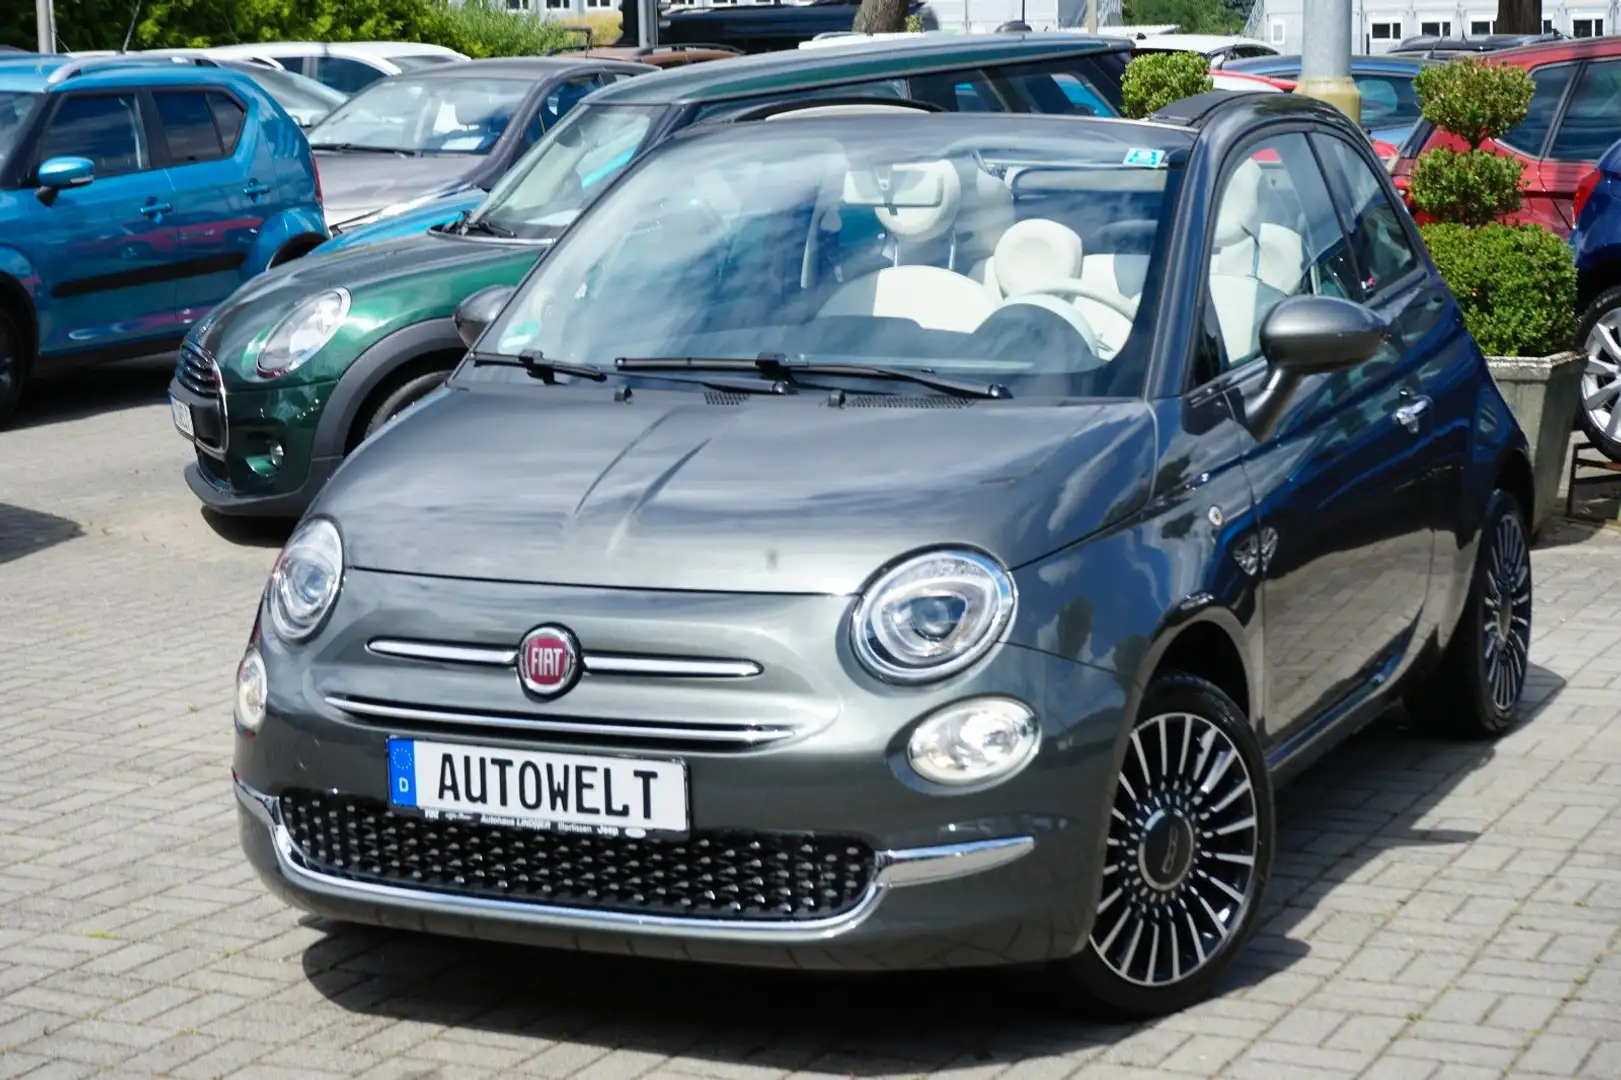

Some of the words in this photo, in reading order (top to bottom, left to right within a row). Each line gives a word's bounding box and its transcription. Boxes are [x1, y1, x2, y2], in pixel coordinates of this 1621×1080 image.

[531, 647, 563, 677] FIAT
[398, 777, 410, 793] D
[437, 752, 659, 820] AUTOWELT
